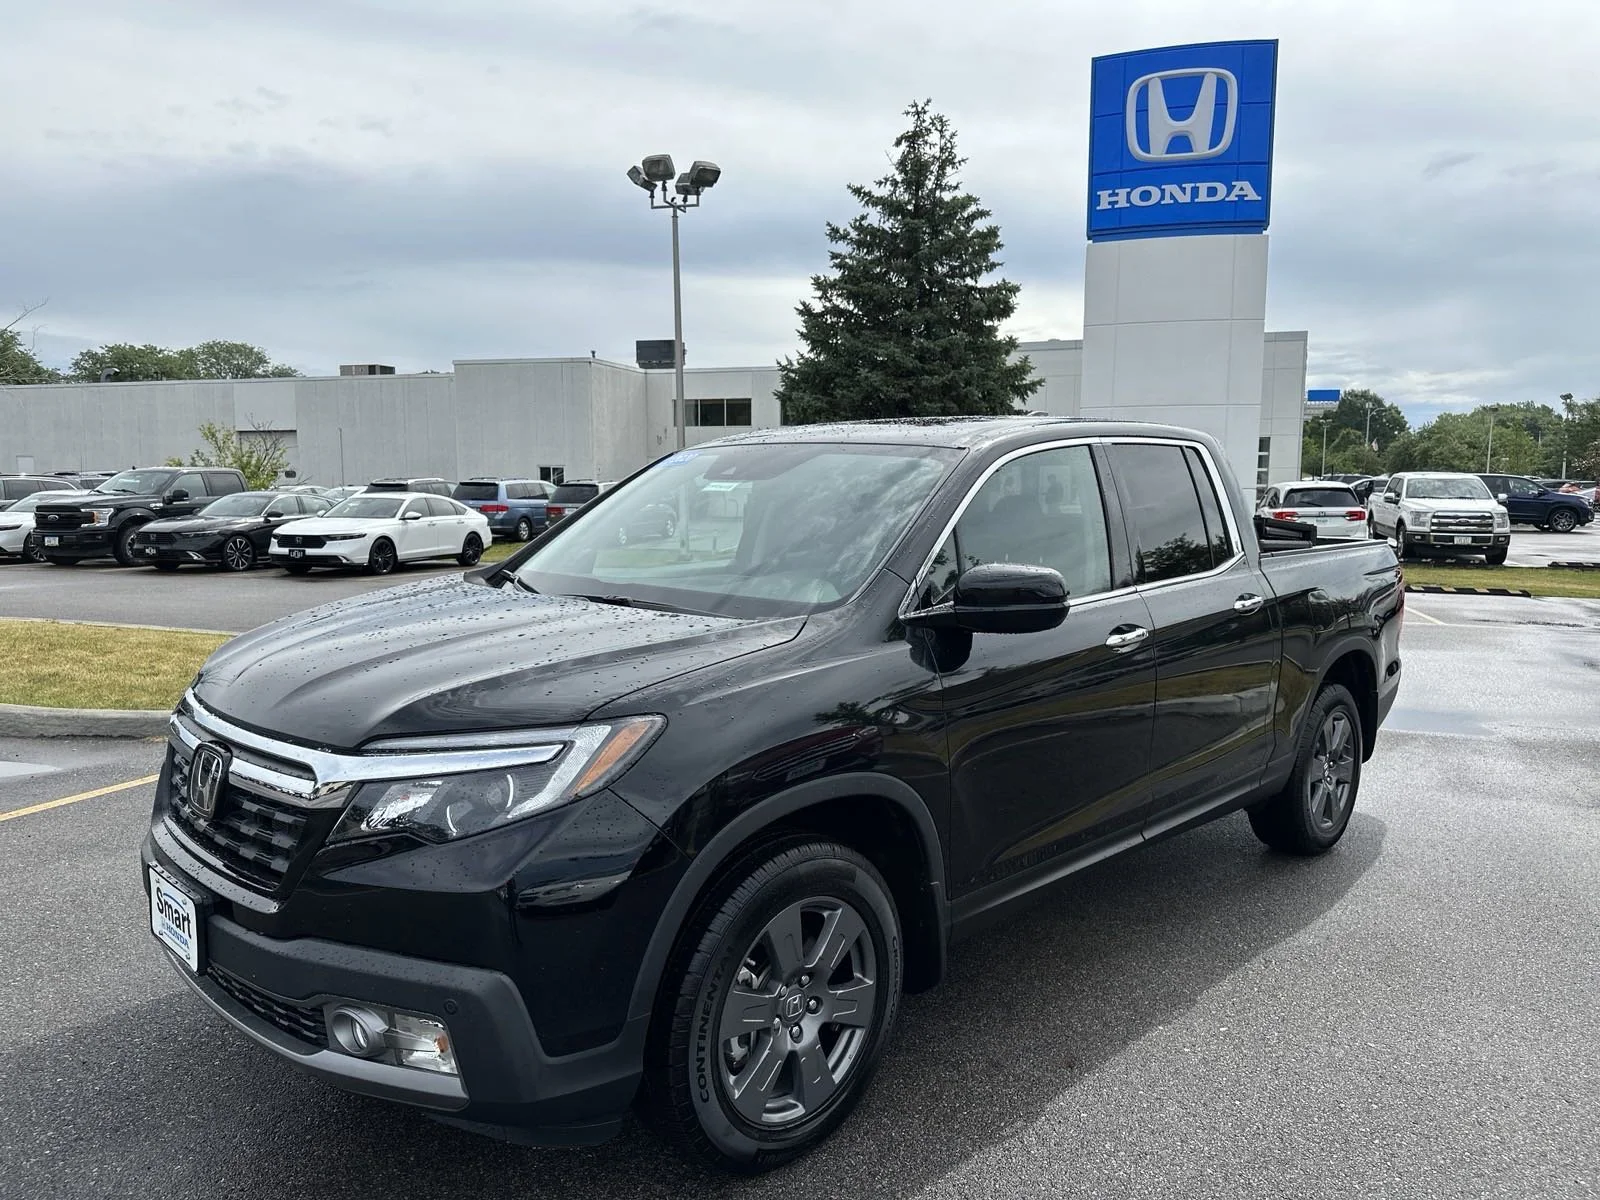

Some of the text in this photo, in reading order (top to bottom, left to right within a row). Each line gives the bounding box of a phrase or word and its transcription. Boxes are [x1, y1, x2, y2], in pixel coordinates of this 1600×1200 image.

[1096, 181, 1262, 210] HONDA
[156, 886, 192, 940] Smart
[166, 921, 190, 949] HONDA
